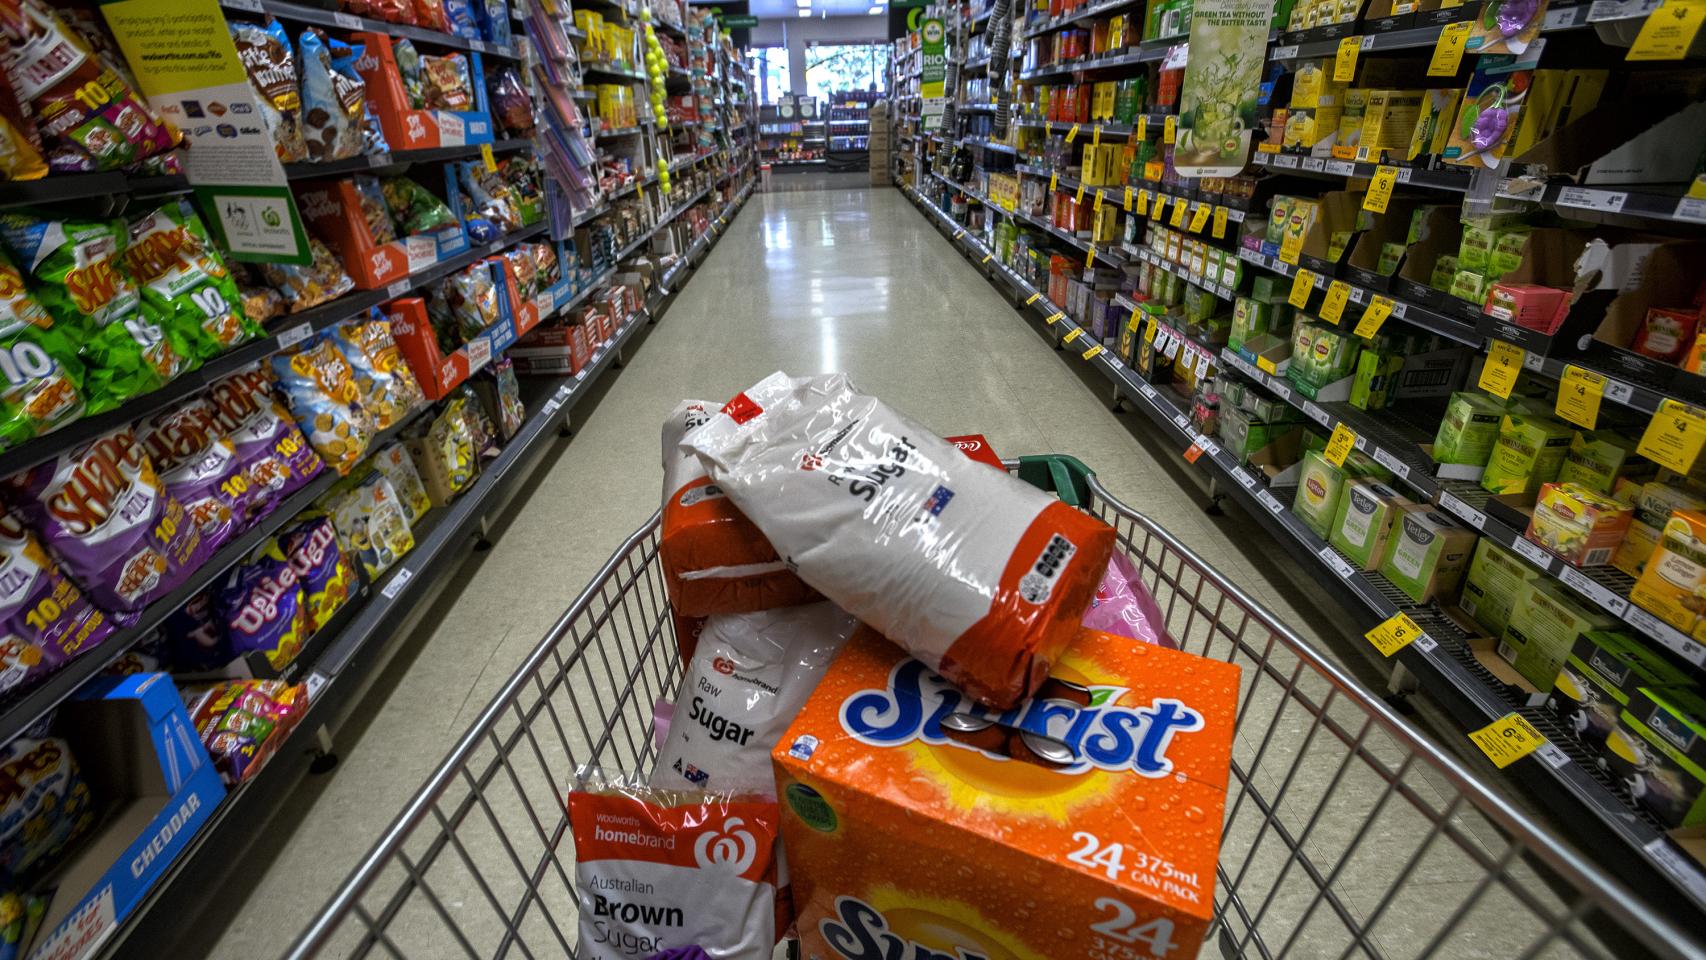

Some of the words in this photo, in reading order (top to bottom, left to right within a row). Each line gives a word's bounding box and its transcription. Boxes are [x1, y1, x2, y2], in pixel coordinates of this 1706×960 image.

[1232, 11, 1265, 19] WITHOUT
[924, 54, 944, 65] RIO
[74, 81, 111, 110] 10
[190, 286, 228, 318] 10
[849, 436, 917, 502] Sugar
[221, 474, 248, 498] 10
[1307, 478, 1325, 498] Lipton
[120, 491, 151, 525] PIZZA
[1353, 490, 1375, 511] Tetley
[1552, 503, 1575, 519] Lipton
[155, 516, 177, 544] 10
[1407, 520, 1430, 543] Tetley
[228, 565, 295, 634] Uglie
[25, 596, 61, 632] 10
[697, 676, 722, 698] Raw
[732, 672, 779, 696] homebrand
[688, 696, 755, 747] Sugar
[596, 813, 641, 828] woolworths
[130, 792, 201, 880] CHEDDAR
[595, 826, 676, 850] homebrand
[1066, 830, 1126, 880] 24
[1134, 851, 1200, 889] 375mL
[589, 874, 655, 895] Australian
[1130, 869, 1161, 890] CAN
[1162, 879, 1200, 905] PACK
[593, 894, 684, 928] Brown
[593, 920, 664, 955] Sugar
[1089, 896, 1179, 958] 24
